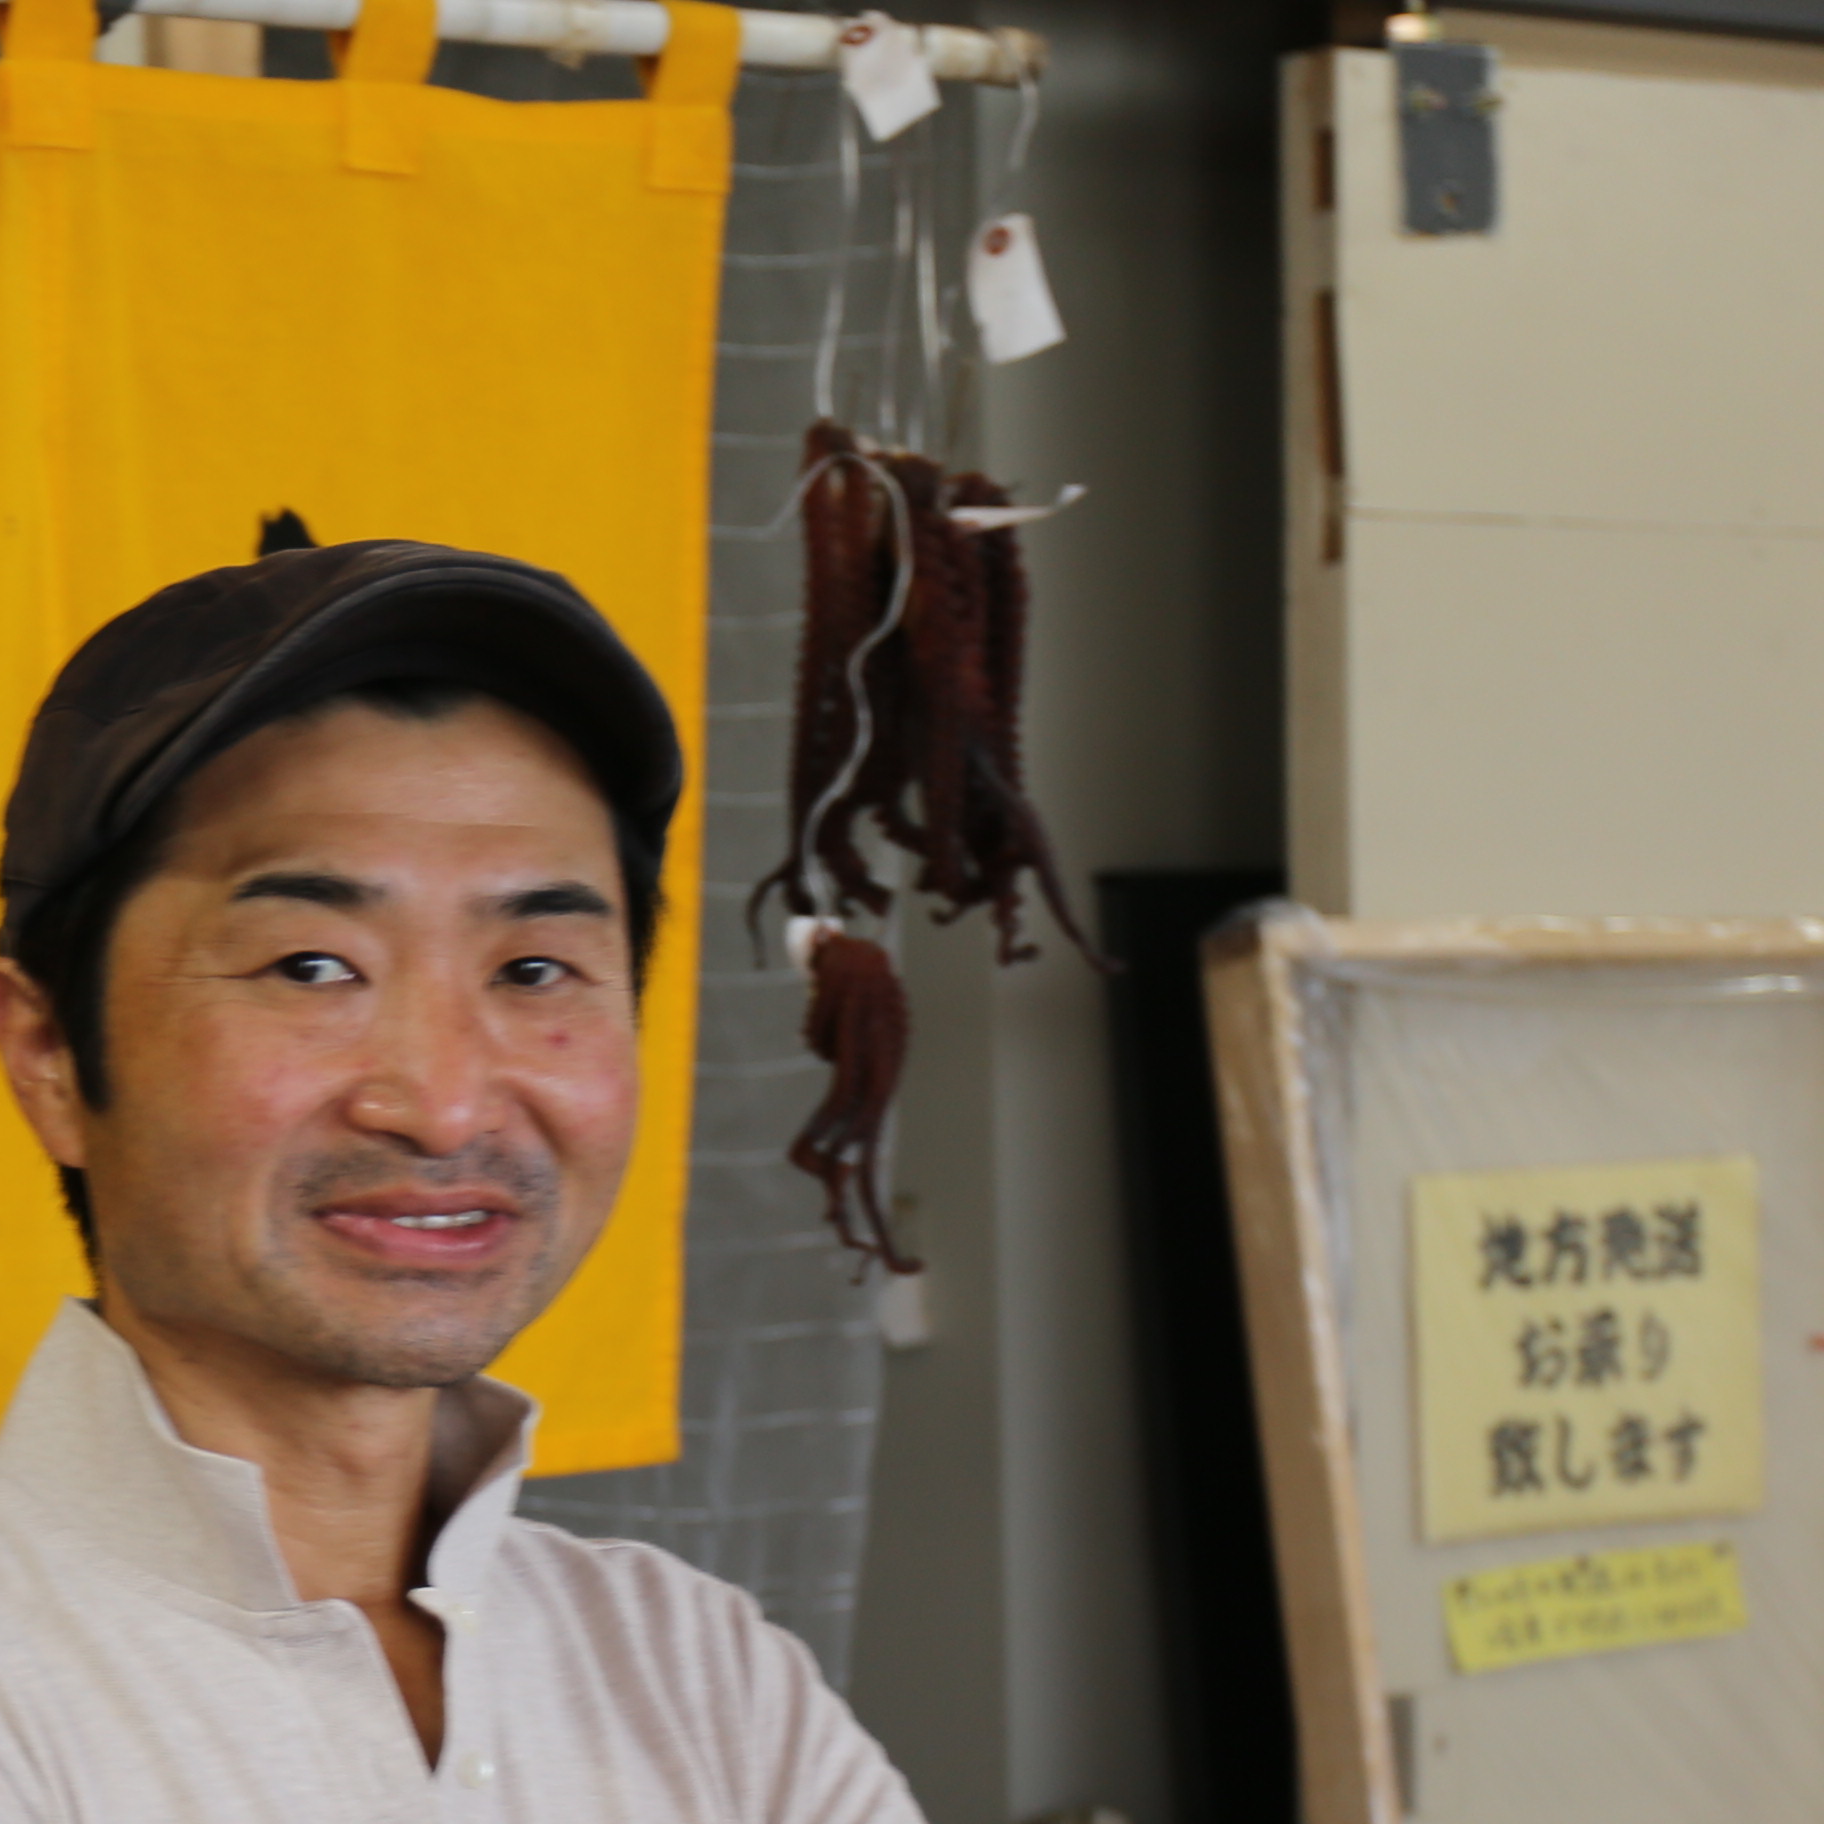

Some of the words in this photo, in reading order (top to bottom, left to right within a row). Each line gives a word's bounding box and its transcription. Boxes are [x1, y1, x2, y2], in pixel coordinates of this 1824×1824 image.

[1477, 1198, 1704, 1289] 地方発送
[1486, 1411, 1707, 1498] 致します
